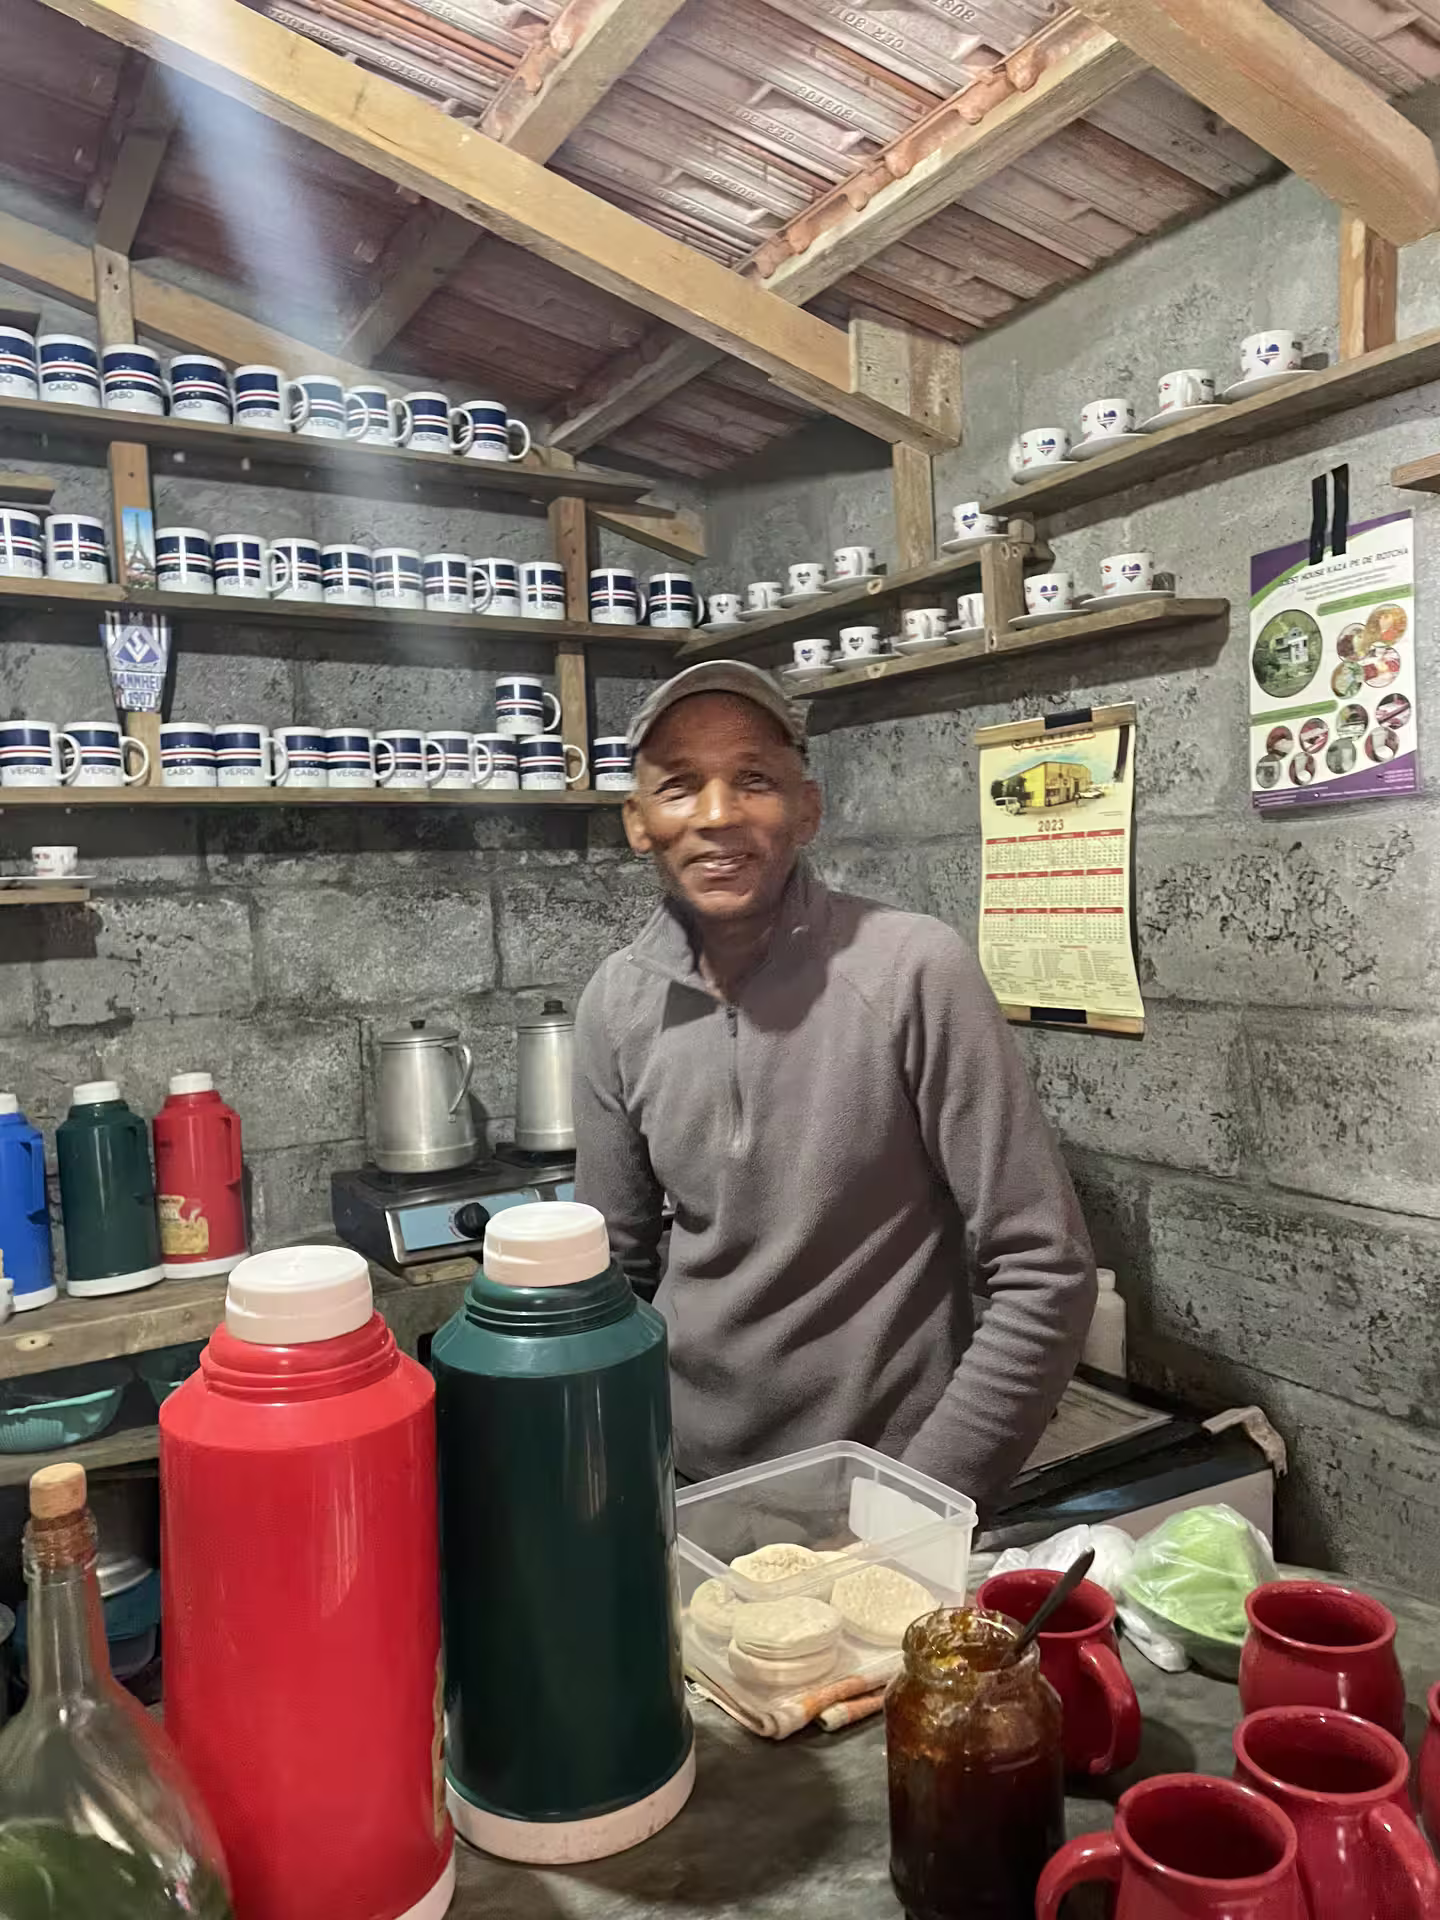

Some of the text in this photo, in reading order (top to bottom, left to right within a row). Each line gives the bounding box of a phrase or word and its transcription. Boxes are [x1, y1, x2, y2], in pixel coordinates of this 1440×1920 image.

[48, 382, 79, 392] CABO
[242, 408, 274, 418] VERDE
[414, 433, 446, 444] VERDE
[476, 440, 506, 451] VERDE
[9, 766, 46, 776] VERDE
[84, 766, 118, 776] VERDE
[166, 767, 195, 777] CABO
[223, 767, 256, 777] VERDE
[294, 767, 322, 777] CABO
[336, 768, 368, 778] VERDE
[1038, 818, 1065, 833] 2023
